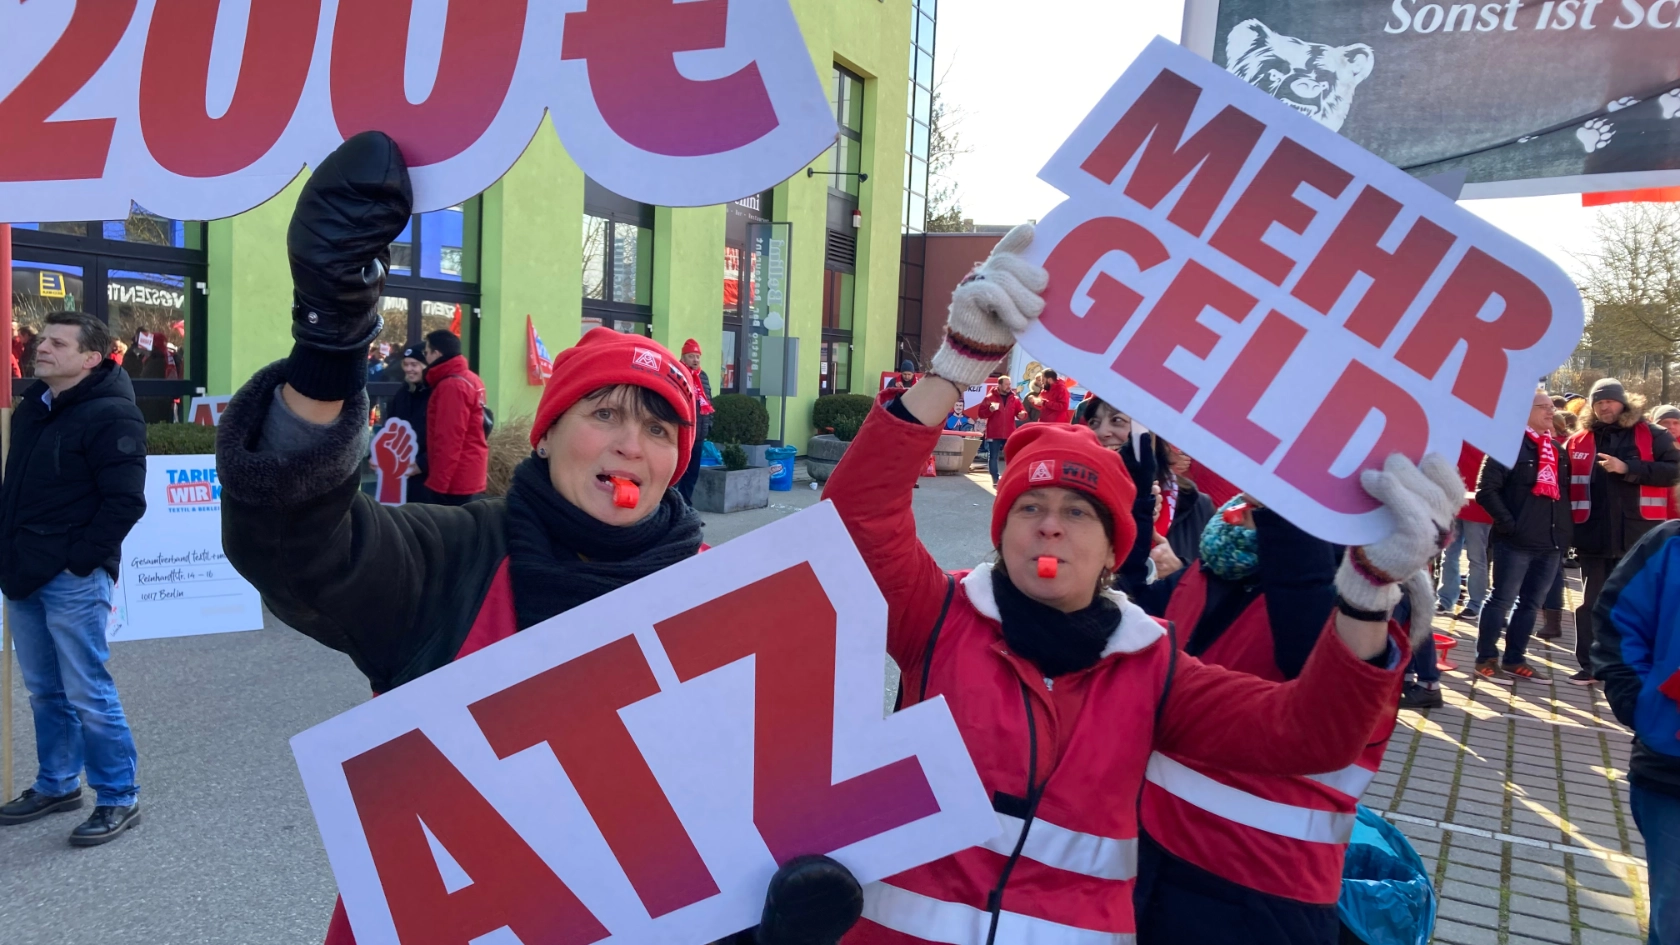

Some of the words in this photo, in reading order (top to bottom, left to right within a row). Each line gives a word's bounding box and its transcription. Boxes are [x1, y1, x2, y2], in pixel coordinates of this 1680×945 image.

[1384, 0, 1524, 34] Sonst
[1535, 0, 1598, 31] ist
[1612, 0, 1680, 30] Sc
[1079, 67, 1553, 420] MEHR
[1037, 215, 1431, 515] GELD
[1062, 464, 1099, 485] WIR
[159, 588, 184, 601] Berlin
[341, 560, 942, 945] ATZ
